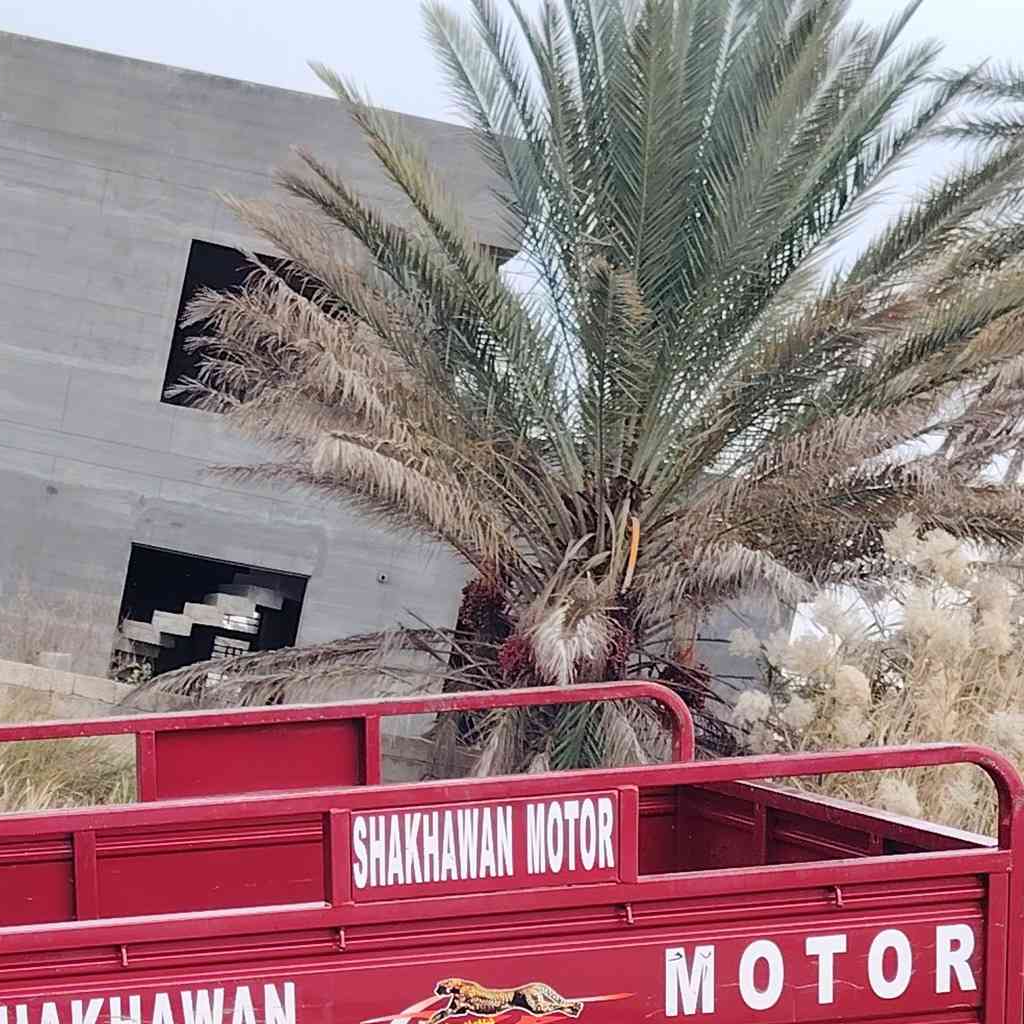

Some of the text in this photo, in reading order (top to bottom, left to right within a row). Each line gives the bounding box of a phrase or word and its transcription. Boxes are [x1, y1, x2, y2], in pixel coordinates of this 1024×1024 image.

[352, 797, 615, 889] SHAKHAWAN MOTOR
[665, 923, 977, 1017] MOTOR
